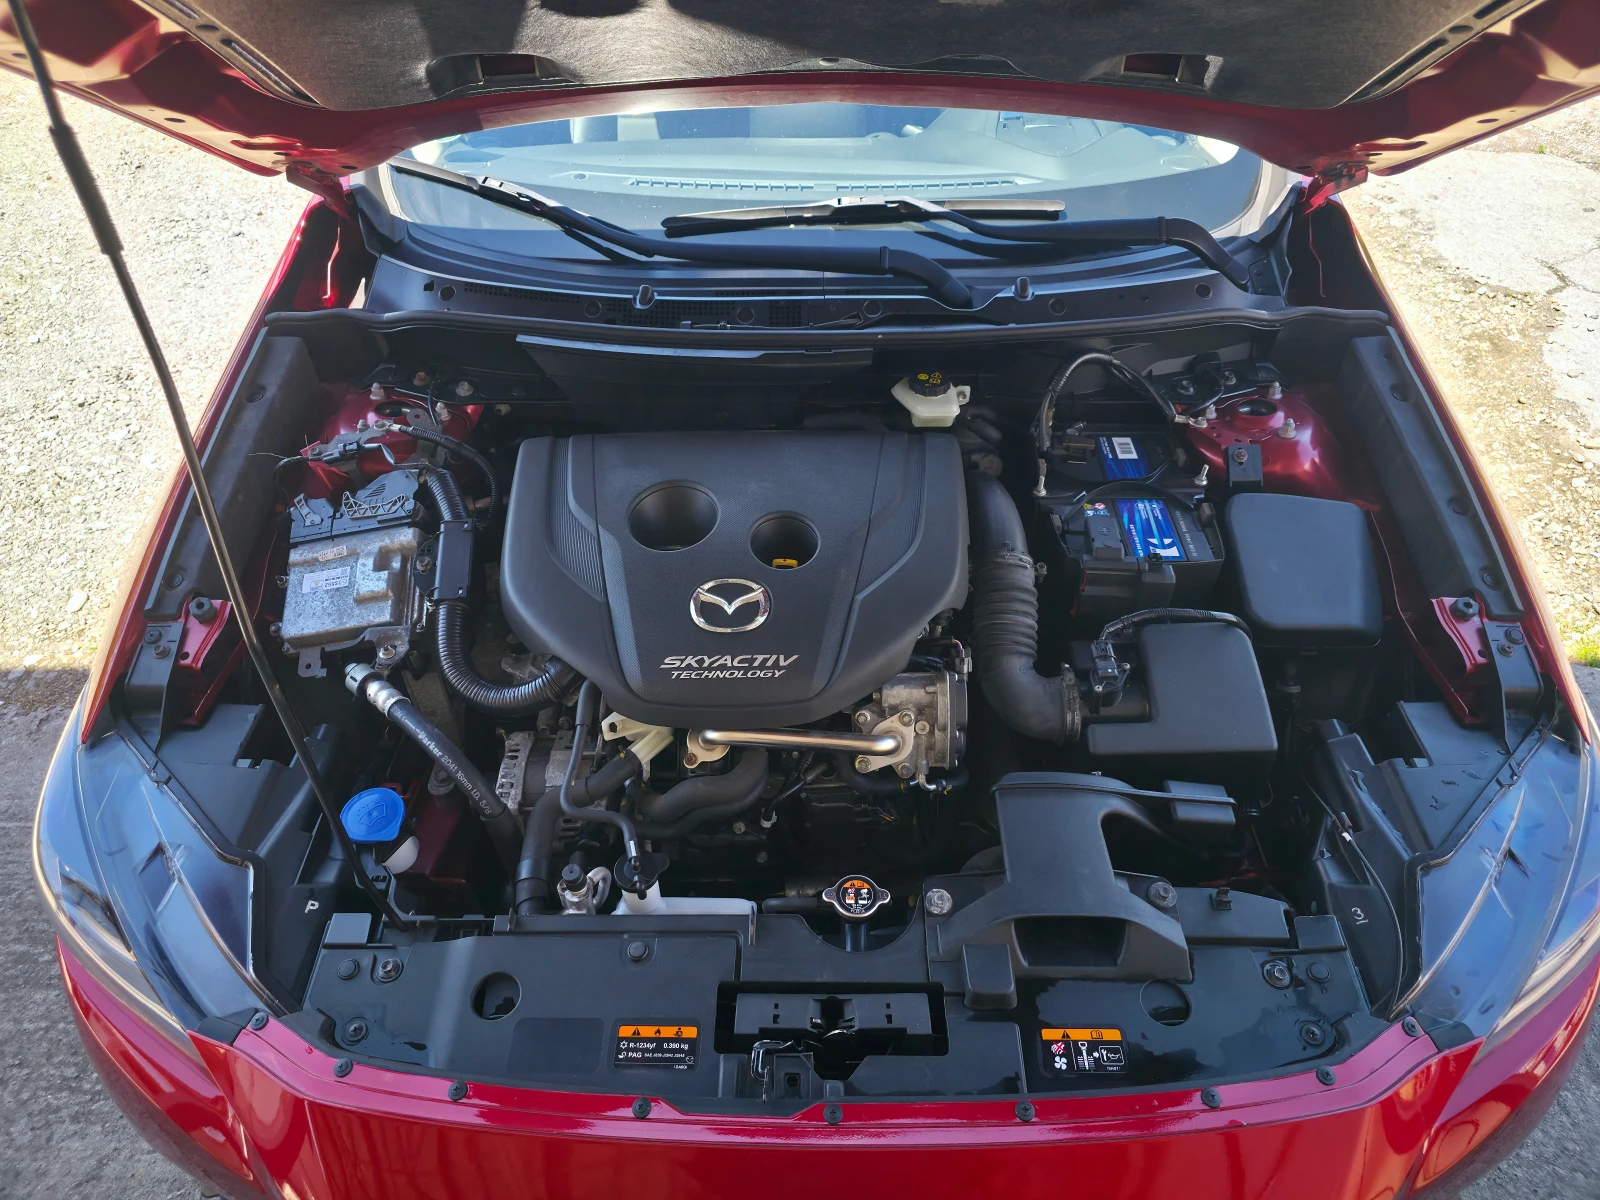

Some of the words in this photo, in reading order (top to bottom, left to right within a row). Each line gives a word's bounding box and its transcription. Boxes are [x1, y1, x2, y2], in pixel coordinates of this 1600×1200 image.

[660, 655, 799, 668] SKYACTIV
[671, 670, 786, 679] TECHNOLOGY
[441, 755, 458, 772] 2041
[456, 770, 473, 791] 16mm
[304, 900, 320, 914] P
[1351, 906, 1365, 920] 3
